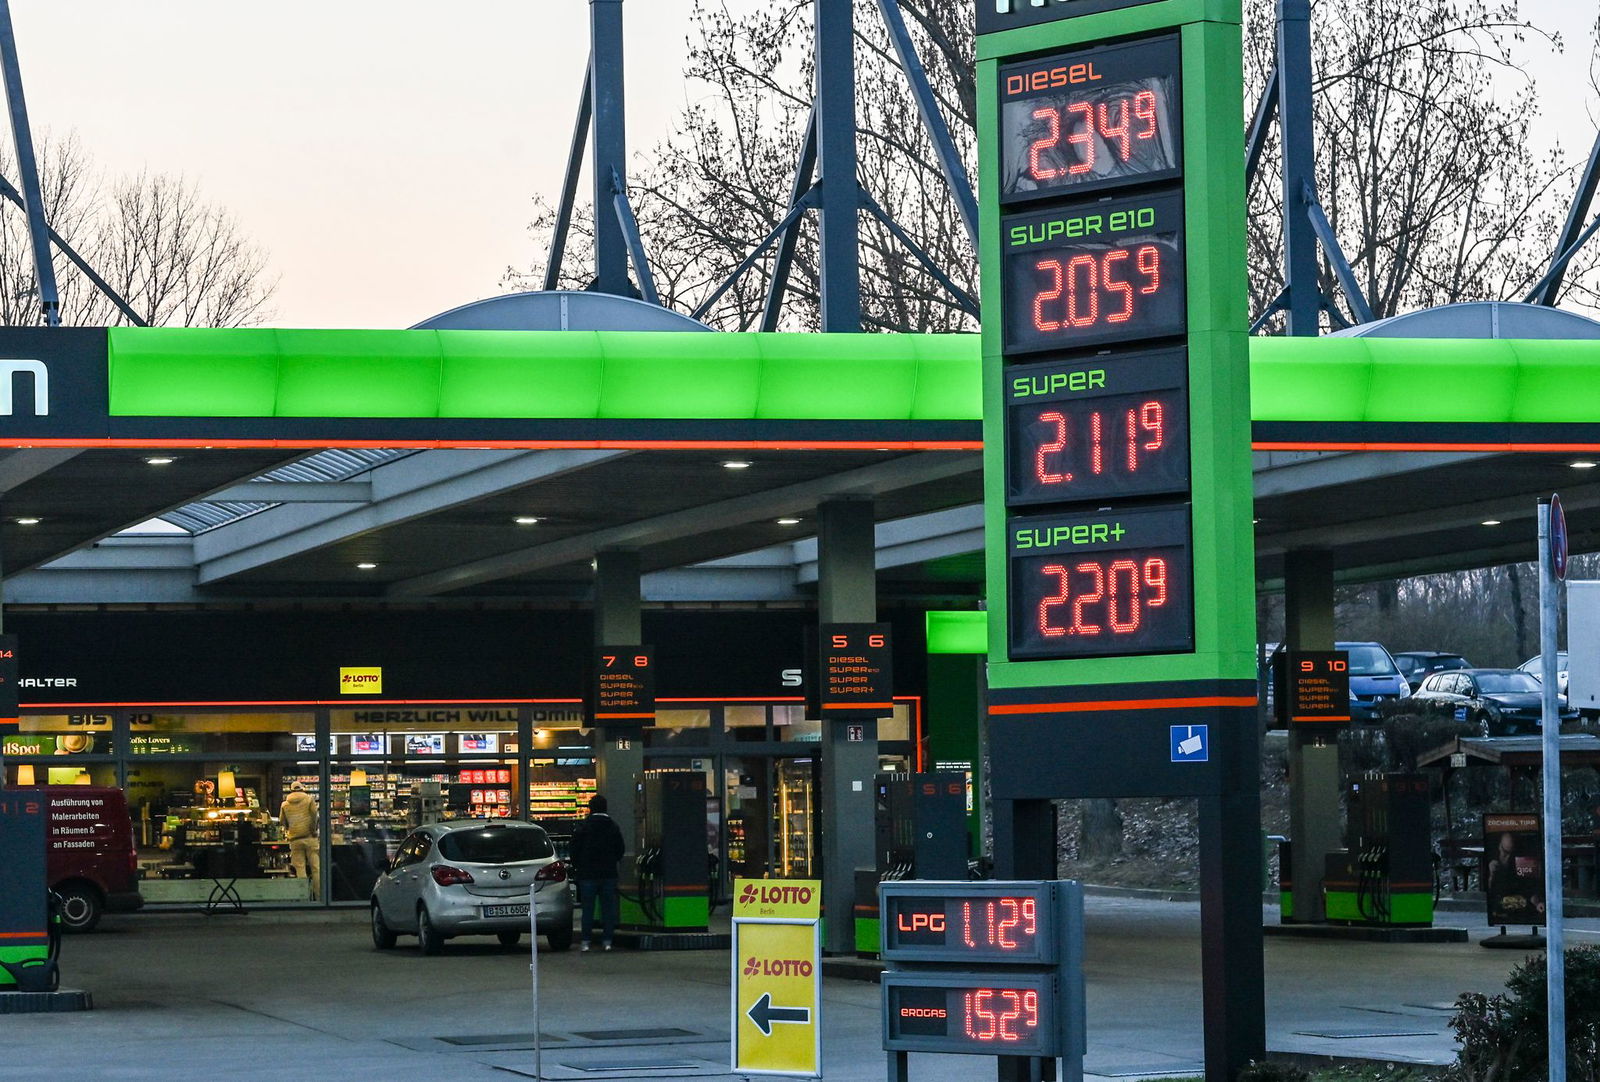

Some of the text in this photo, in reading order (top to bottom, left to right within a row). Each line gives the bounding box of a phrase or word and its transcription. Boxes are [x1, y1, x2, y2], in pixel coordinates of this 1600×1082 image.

[1007, 62, 1102, 95] DIESEL
[1010, 215, 1102, 246] SUPER
[1013, 369, 1106, 398] SUPER
[1015, 522, 1126, 549] SUPER+
[832, 635, 885, 648] 5 6
[602, 656, 648, 667] 7 8
[1301, 661, 1346, 672] 9 10
[353, 675, 379, 683] LOTTO
[68, 714, 153, 725] BISRO
[51, 799, 90, 808] Ausführung
[52, 812, 100, 821] Malerarbeiten
[52, 827, 60, 835] in
[60, 826, 88, 835] Räumen
[53, 840, 95, 849] an Fassaden
[760, 886, 812, 904] LOTTO
[898, 913, 946, 932] LPG
[763, 959, 813, 977] LOTTO
